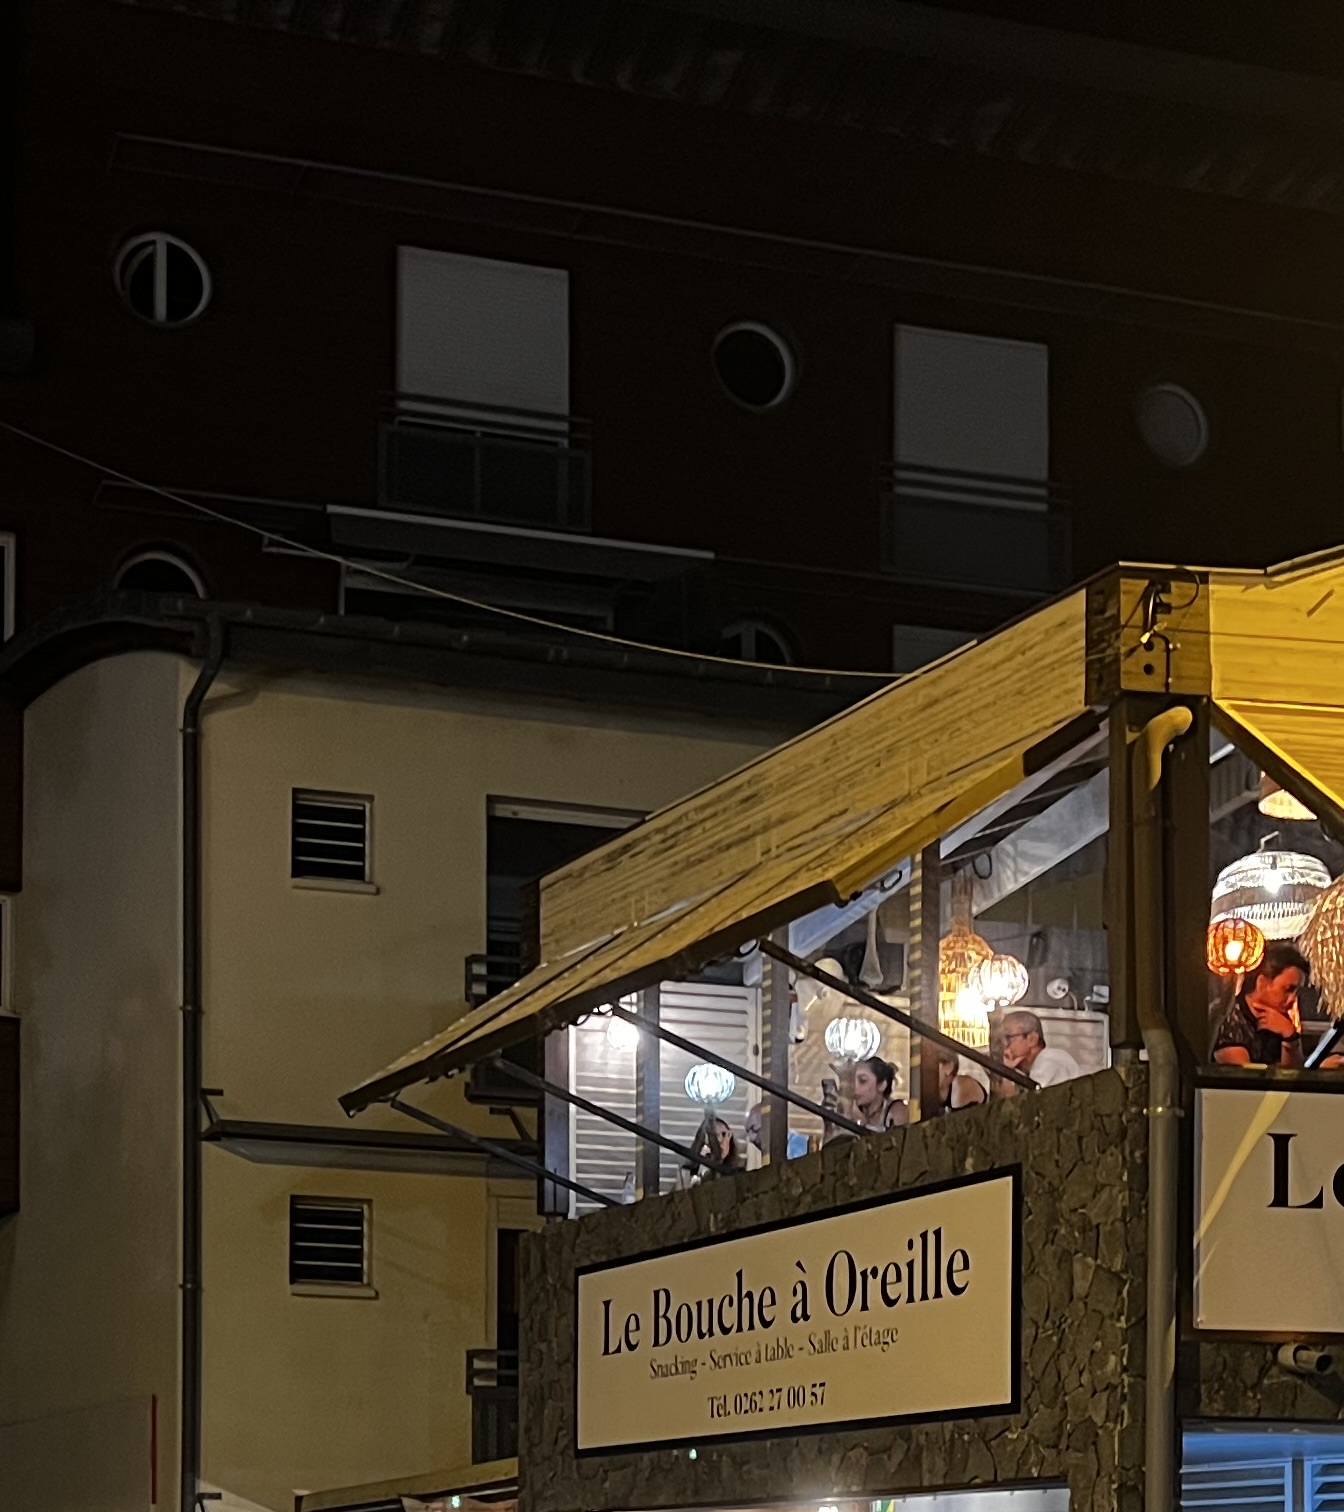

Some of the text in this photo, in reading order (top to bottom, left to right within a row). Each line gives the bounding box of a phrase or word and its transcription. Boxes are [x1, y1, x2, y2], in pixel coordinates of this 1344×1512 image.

[601, 1226, 970, 1356] Le Bouche à Oreille
[649, 1354, 698, 1381] Snacking
[709, 1348, 752, 1371] Service
[754, 1341, 762, 1364] à
[764, 1337, 794, 1363] table
[807, 1330, 839, 1357] Salle
[842, 1327, 850, 1352] à
[853, 1324, 899, 1353] l'étage
[707, 1381, 827, 1419] Tél. 0262 27 00 57
